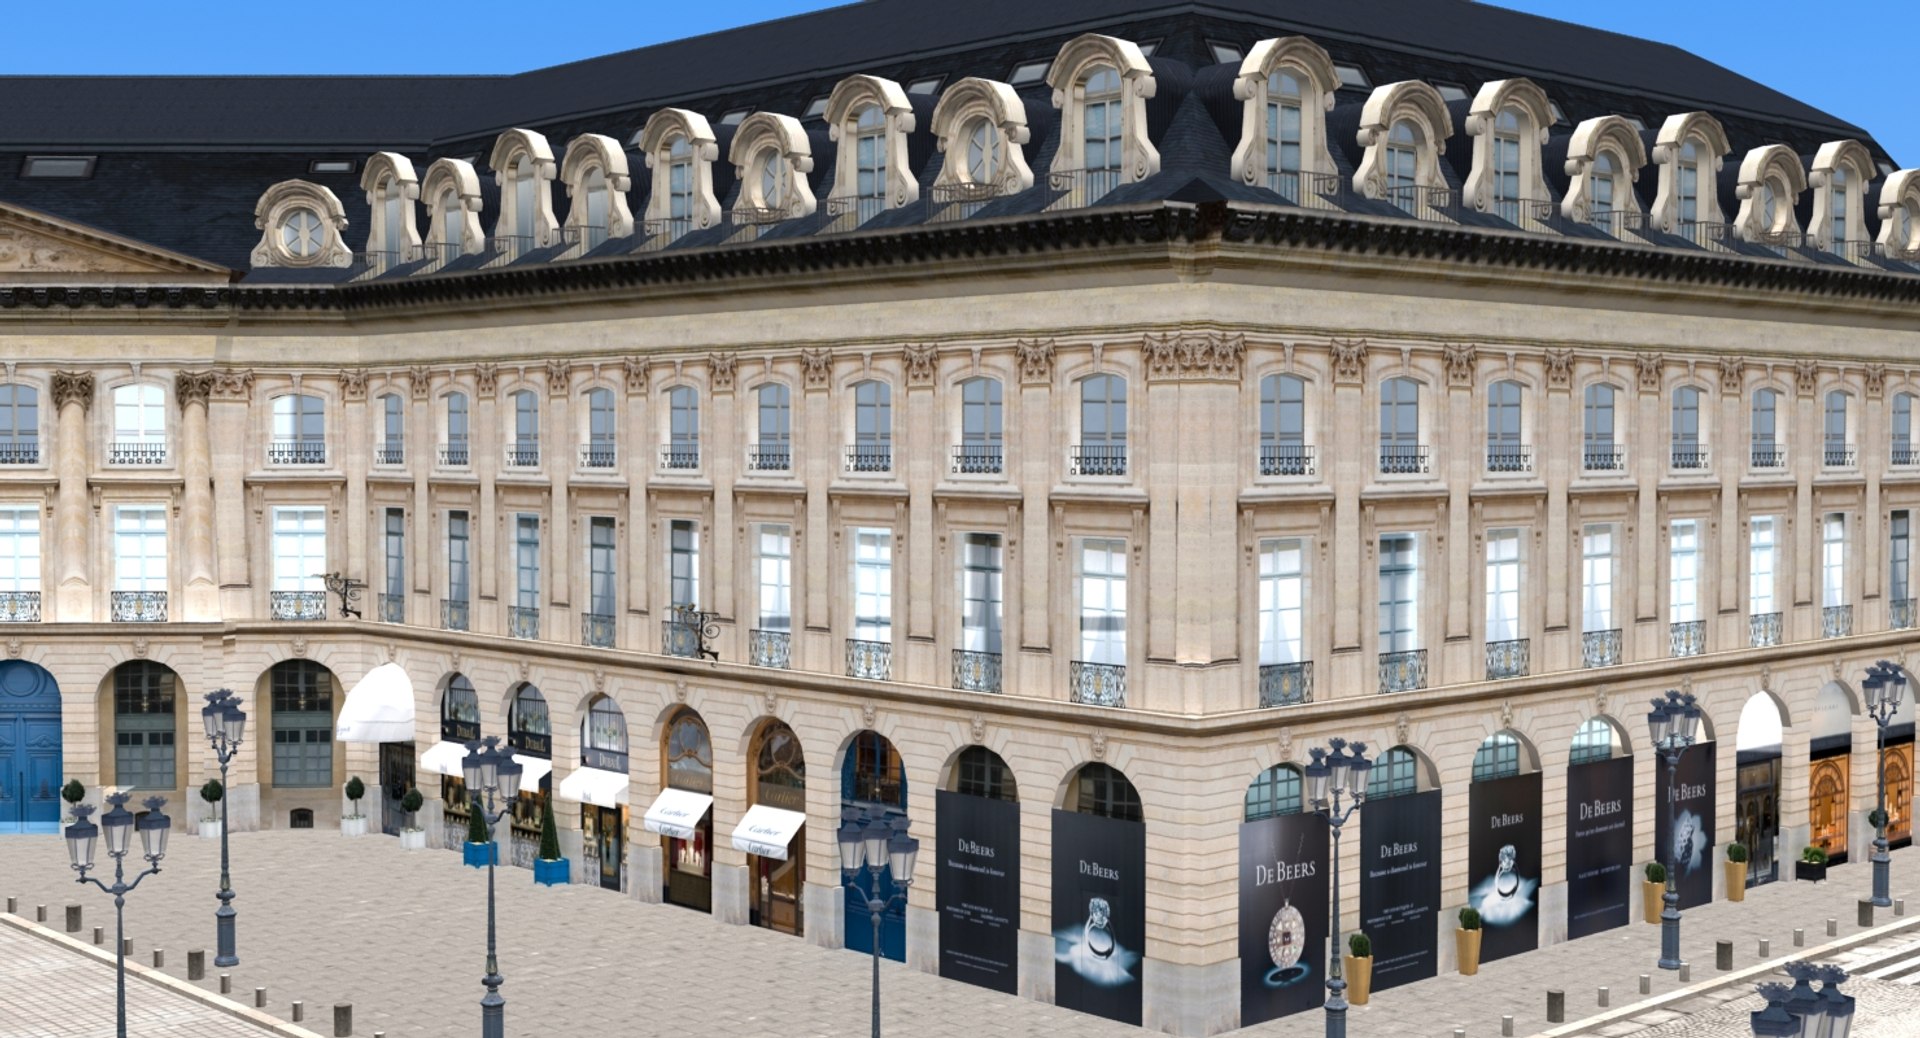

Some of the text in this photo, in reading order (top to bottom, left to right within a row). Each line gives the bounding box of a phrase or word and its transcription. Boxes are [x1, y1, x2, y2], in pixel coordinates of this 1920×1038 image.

[1681, 783, 1706, 800] BEERS
[1594, 799, 1622, 817] BEERS
[1502, 813, 1523, 827] BEERS
[970, 840, 995, 858] BEERS
[1393, 842, 1418, 856] BEERS
[1092, 862, 1119, 881] BEERS
[1277, 860, 1316, 882] BEERS
